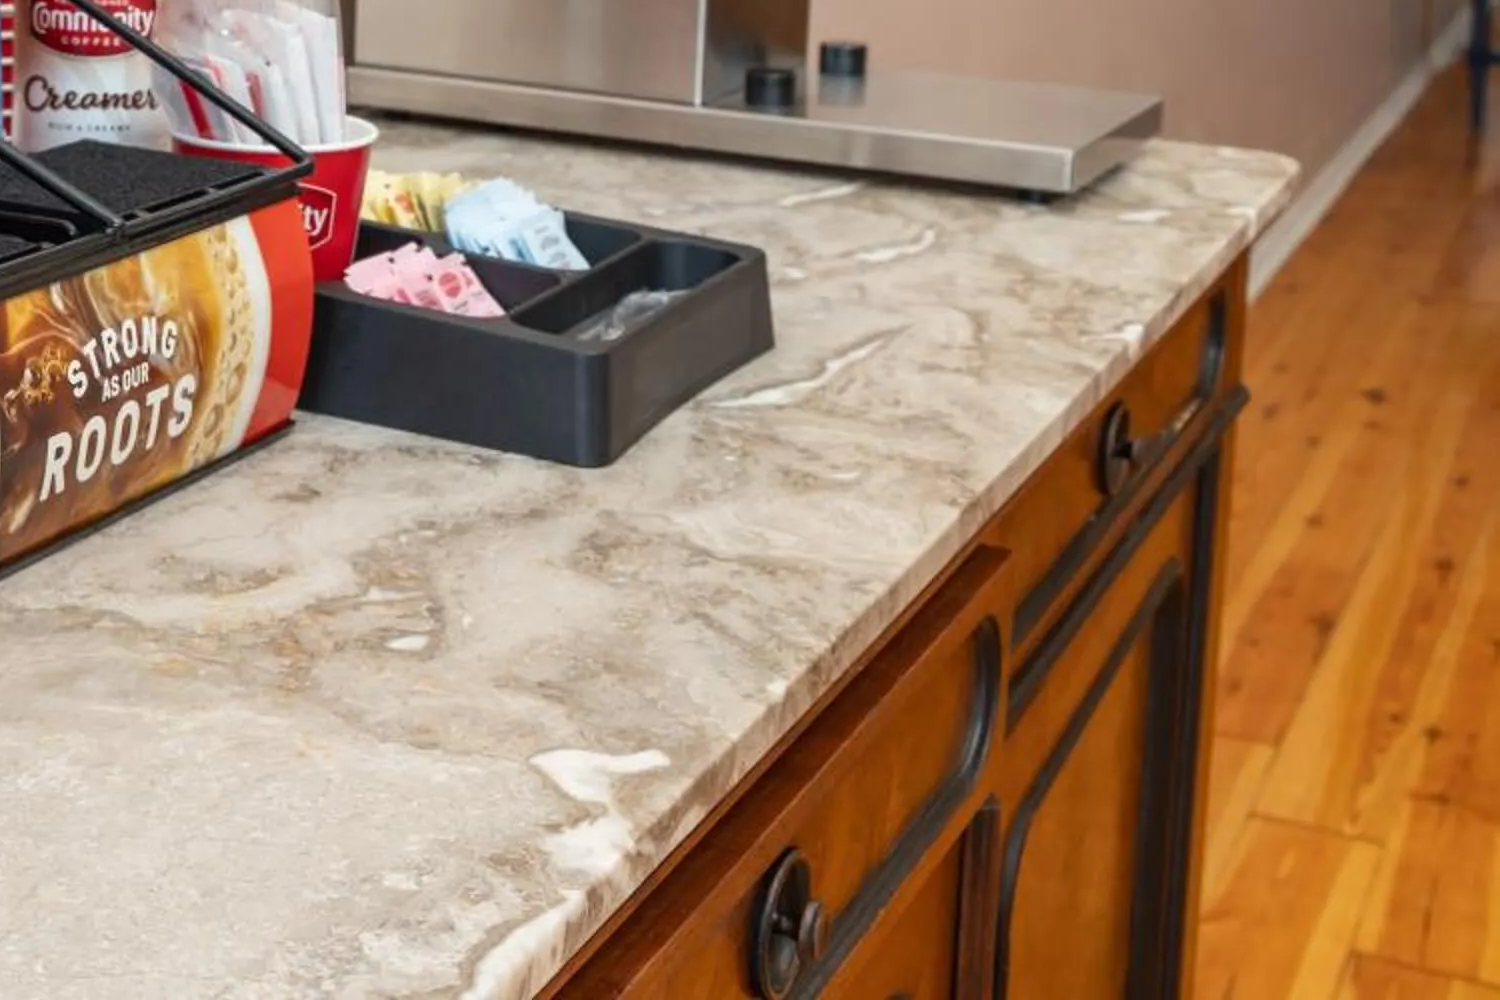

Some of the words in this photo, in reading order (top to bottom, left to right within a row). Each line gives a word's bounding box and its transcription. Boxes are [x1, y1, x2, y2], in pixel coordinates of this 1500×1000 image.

[61, 35, 120, 47] COFFEE
[23, 74, 158, 112] Creamer
[67, 315, 178, 398] STRONG
[102, 374, 121, 402] AS
[122, 361, 150, 392] OUR
[39, 373, 196, 501] ROOTS
